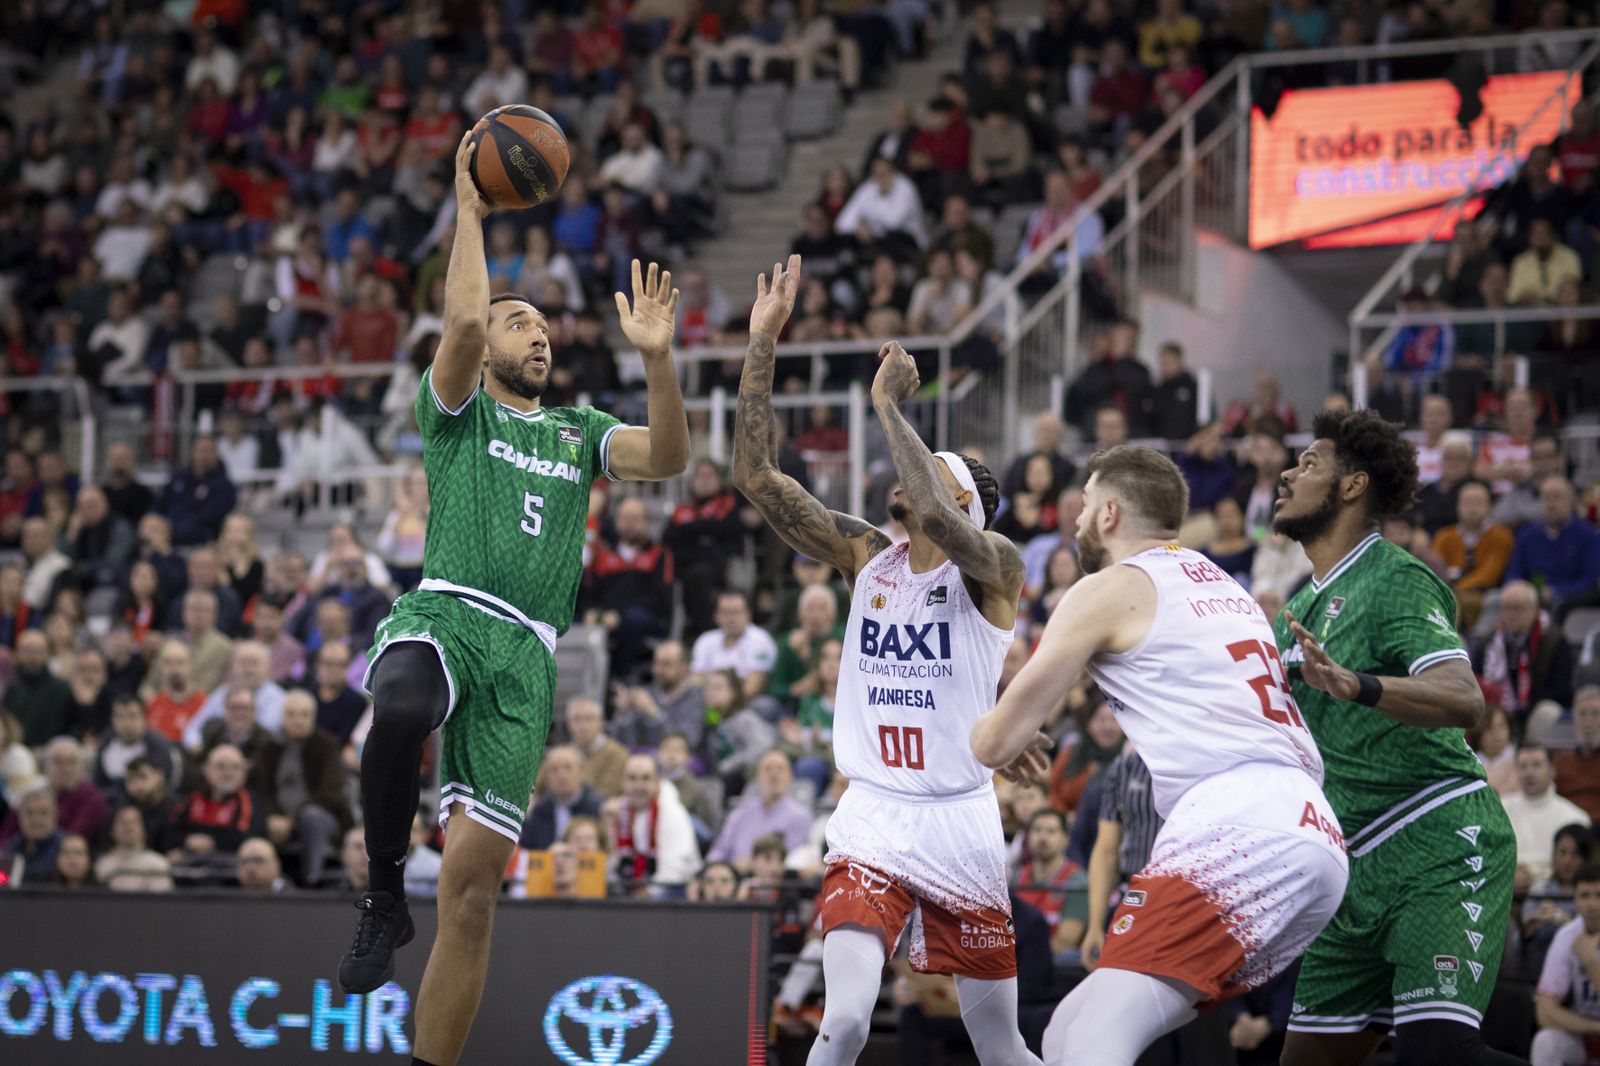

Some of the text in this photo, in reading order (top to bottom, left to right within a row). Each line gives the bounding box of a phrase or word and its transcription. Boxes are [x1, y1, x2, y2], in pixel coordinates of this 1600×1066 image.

[1295, 113, 1519, 161] todo para la
[1295, 147, 1526, 198] construcció
[521, 491, 545, 537] 5
[860, 616, 952, 661] BAXI
[858, 658, 953, 679] CLIMATIZACIÓN
[867, 685, 937, 711] MANRESA
[878, 724, 925, 771] 00
[961, 935, 1010, 949] GLOBAL
[228, 976, 412, 1054] C-HR
